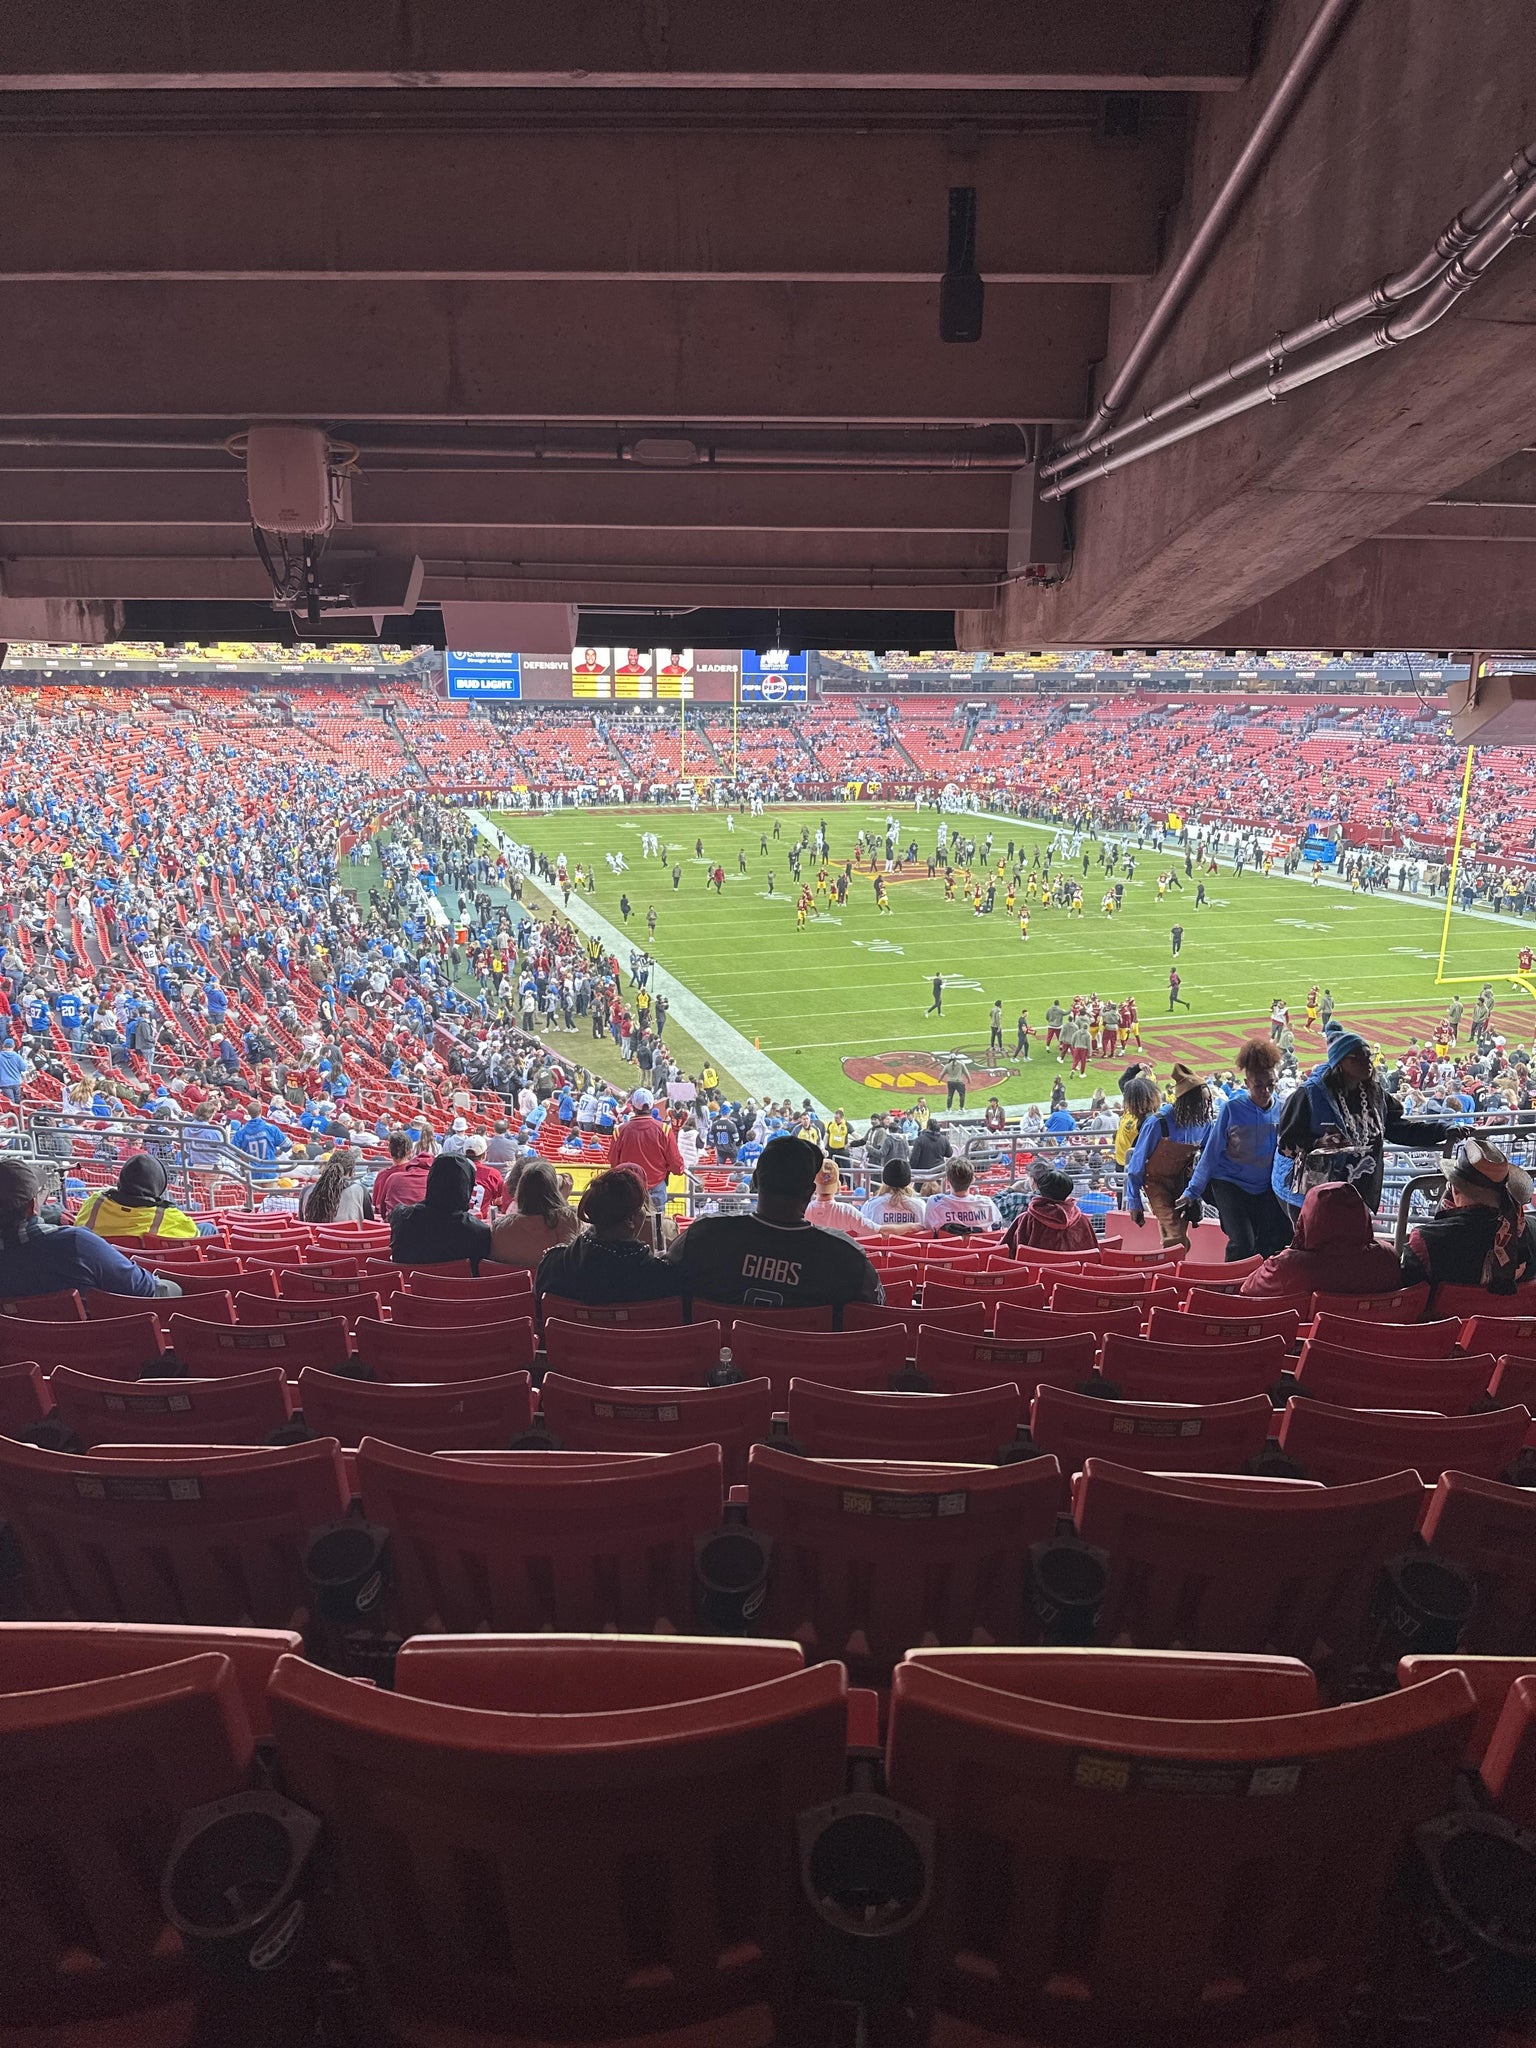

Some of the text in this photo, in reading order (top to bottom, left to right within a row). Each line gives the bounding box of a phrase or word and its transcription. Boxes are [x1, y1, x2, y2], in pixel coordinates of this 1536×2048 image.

[523, 661, 569, 670] DEFENSIVE
[696, 664, 739, 673] LEADERS
[456, 679, 513, 689] BUD LIGHT
[143, 950, 155, 960] 82
[61, 1005, 75, 1017] 20
[248, 1138, 268, 1160] 97
[883, 1212, 916, 1223] GRIBBIN
[945, 1210, 987, 1222] ST BROWN
[741, 1253, 802, 1286] GIBBS
